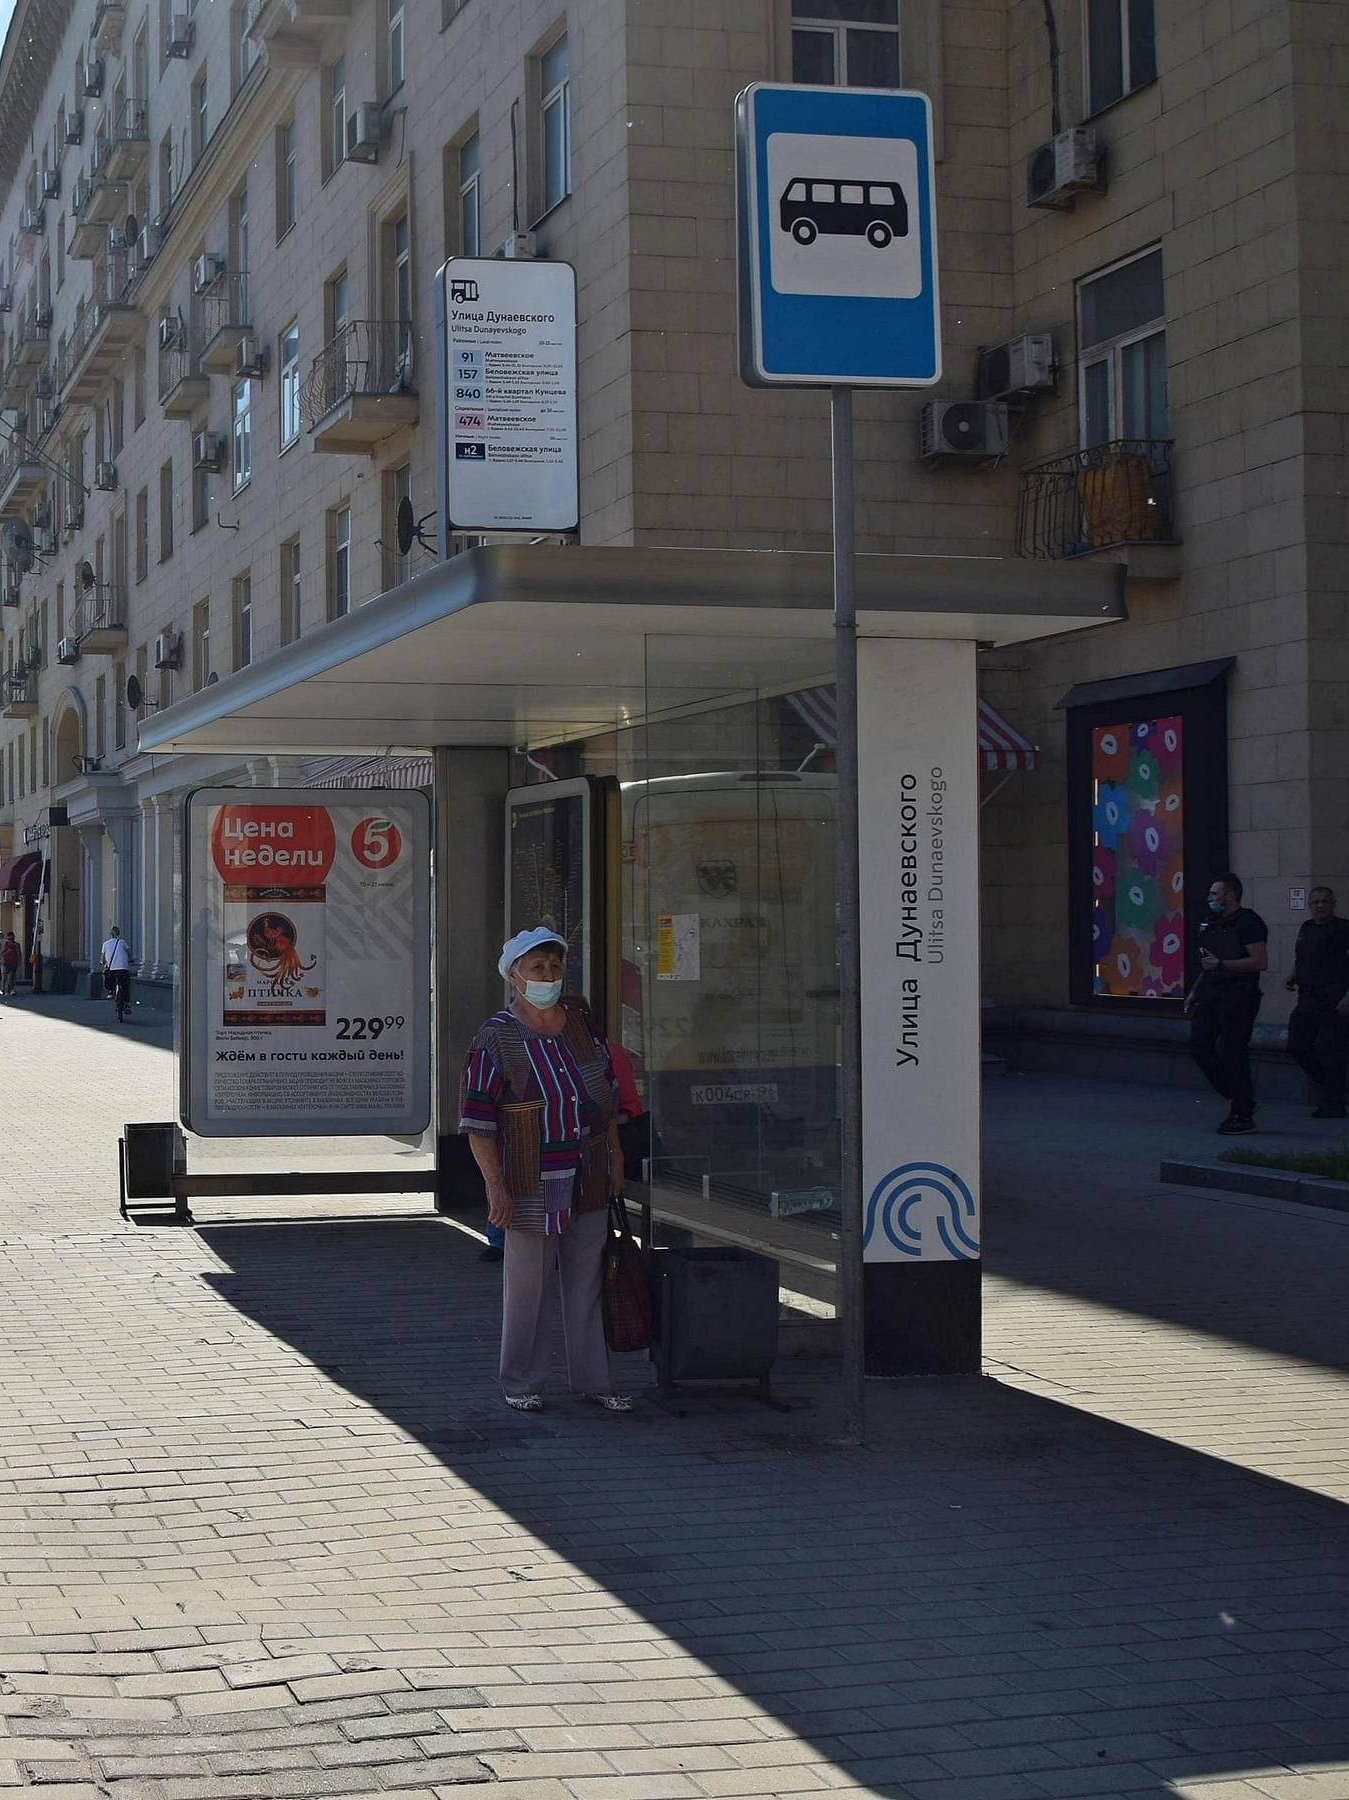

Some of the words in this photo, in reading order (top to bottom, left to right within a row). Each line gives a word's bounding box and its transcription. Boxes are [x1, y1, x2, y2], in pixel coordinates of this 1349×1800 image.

[451, 310, 484, 322] Улица
[487, 311, 555, 323] Дунаевского
[451, 325, 472, 333] Ulitsa
[474, 326, 527, 335] Dunayevskogo
[461, 352, 474, 363] 91
[458, 369, 478, 379] 157
[485, 368, 535, 376] Беловежская
[456, 388, 481, 399] 840
[459, 416, 481, 426] 474
[464, 445, 477, 455] н2
[224, 817, 294, 841] Цена
[927, 766, 946, 902] Dunaevskogo
[362, 819, 394, 862] 5
[224, 845, 324, 866] недели
[896, 774, 923, 963] Дунаевского
[927, 908, 945, 964] Ulitsa
[248, 988, 302, 998] ПТИЧКА
[896, 979, 922, 1067] Улица
[215, 1050, 255, 1062] Ждём
[259, 1052, 266, 1061] в
[270, 1052, 308, 1061] гости
[311, 1050, 366, 1062] каждый
[369, 1050, 404, 1062] день!
